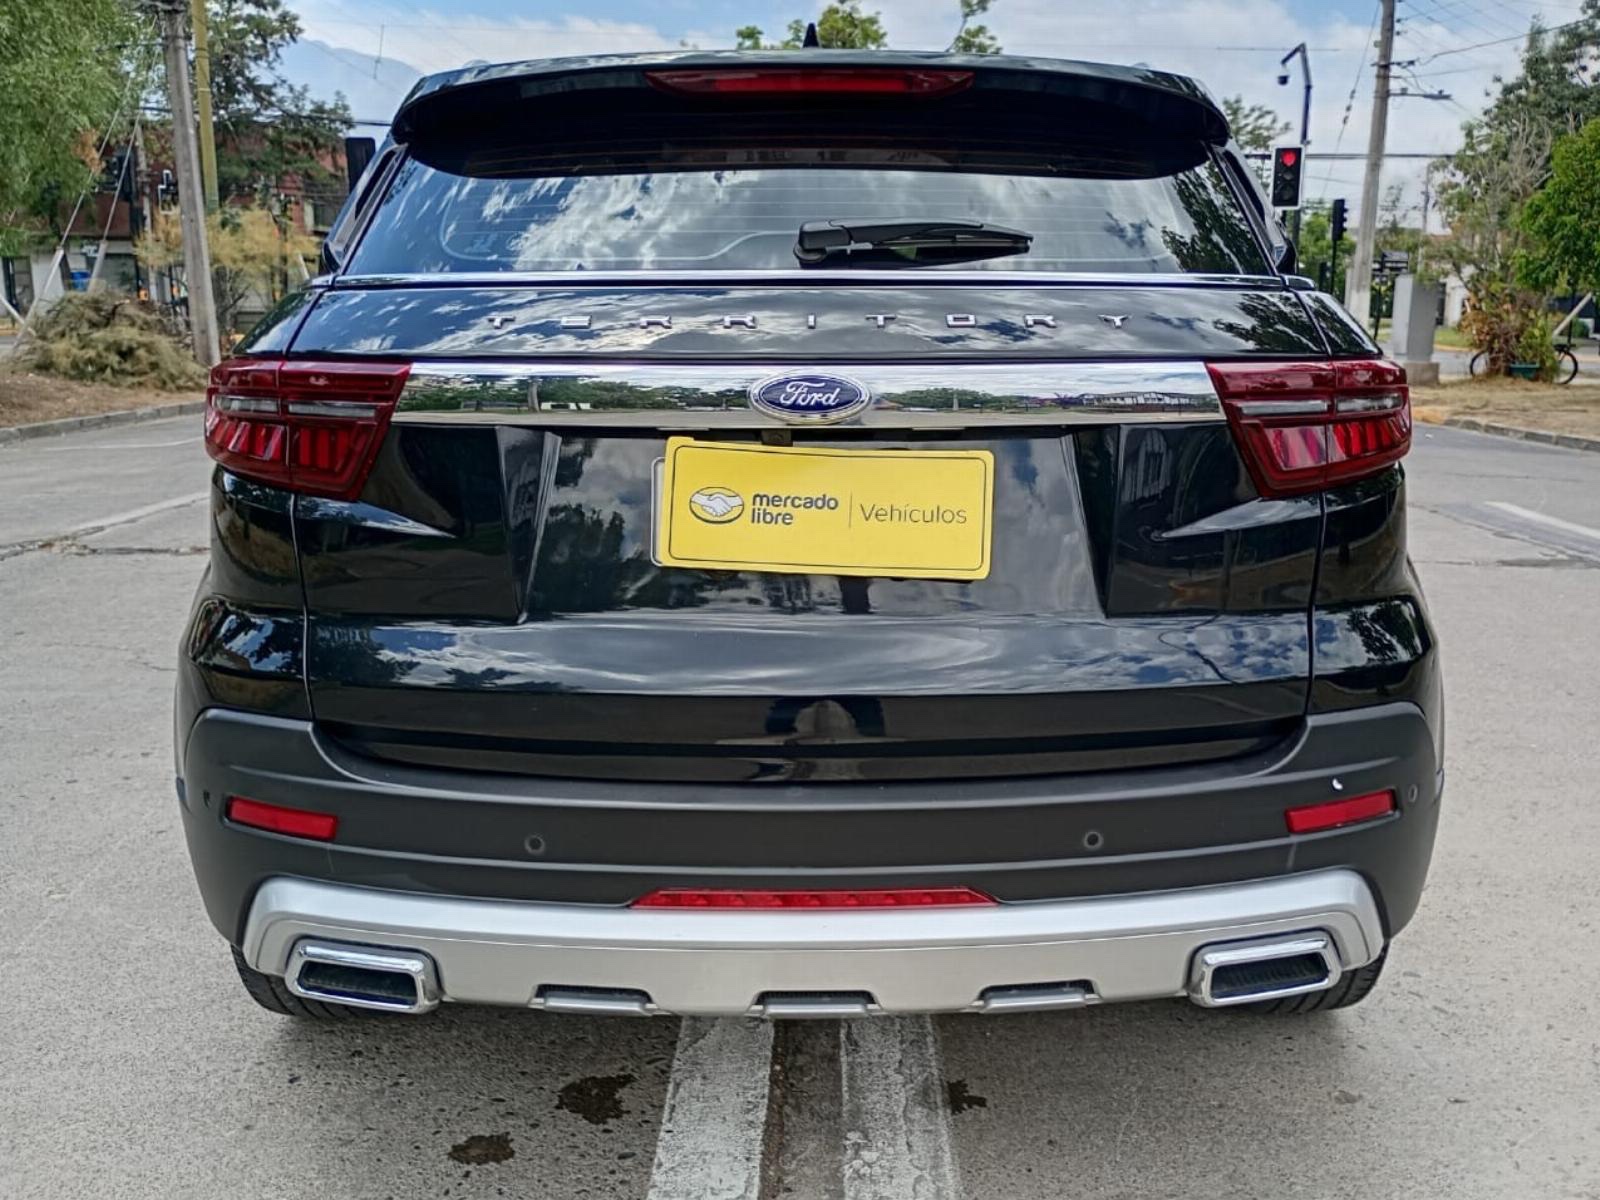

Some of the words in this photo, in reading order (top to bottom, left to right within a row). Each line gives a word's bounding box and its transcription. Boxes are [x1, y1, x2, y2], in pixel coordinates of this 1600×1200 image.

[488, 314, 1129, 329] TERRITORY
[780, 381, 840, 405] Ford
[752, 494, 838, 511] mercado
[751, 509, 793, 526] libre
[860, 503, 967, 525] Vehículos
